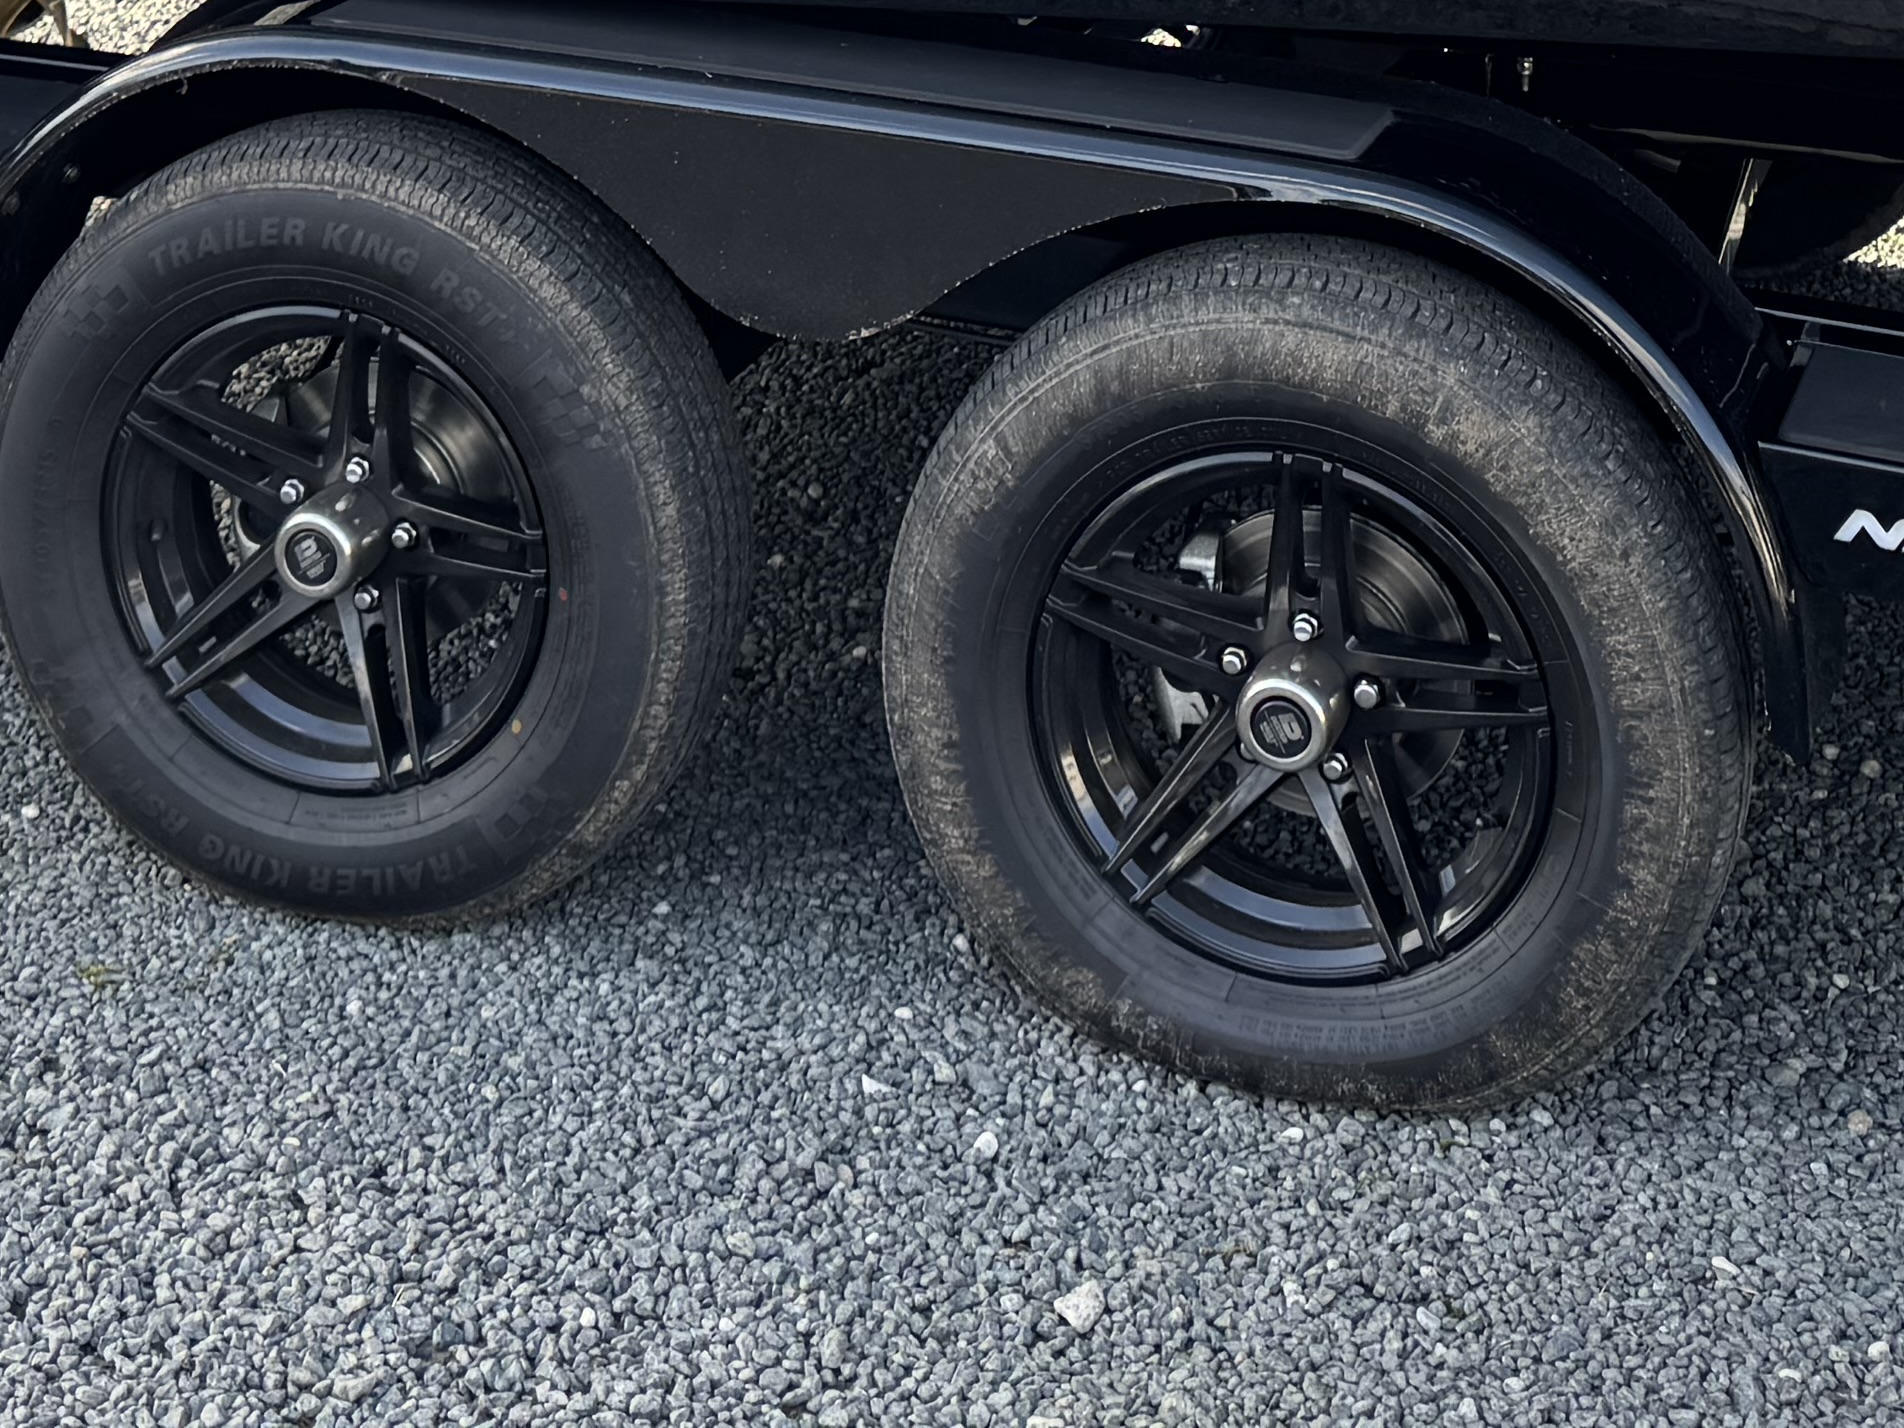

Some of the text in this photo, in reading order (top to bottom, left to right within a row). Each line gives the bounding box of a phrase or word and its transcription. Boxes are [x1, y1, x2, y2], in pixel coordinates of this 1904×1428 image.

[147, 216, 308, 278] TRAILER
[320, 219, 421, 276] KING
[196, 830, 292, 890] KING
